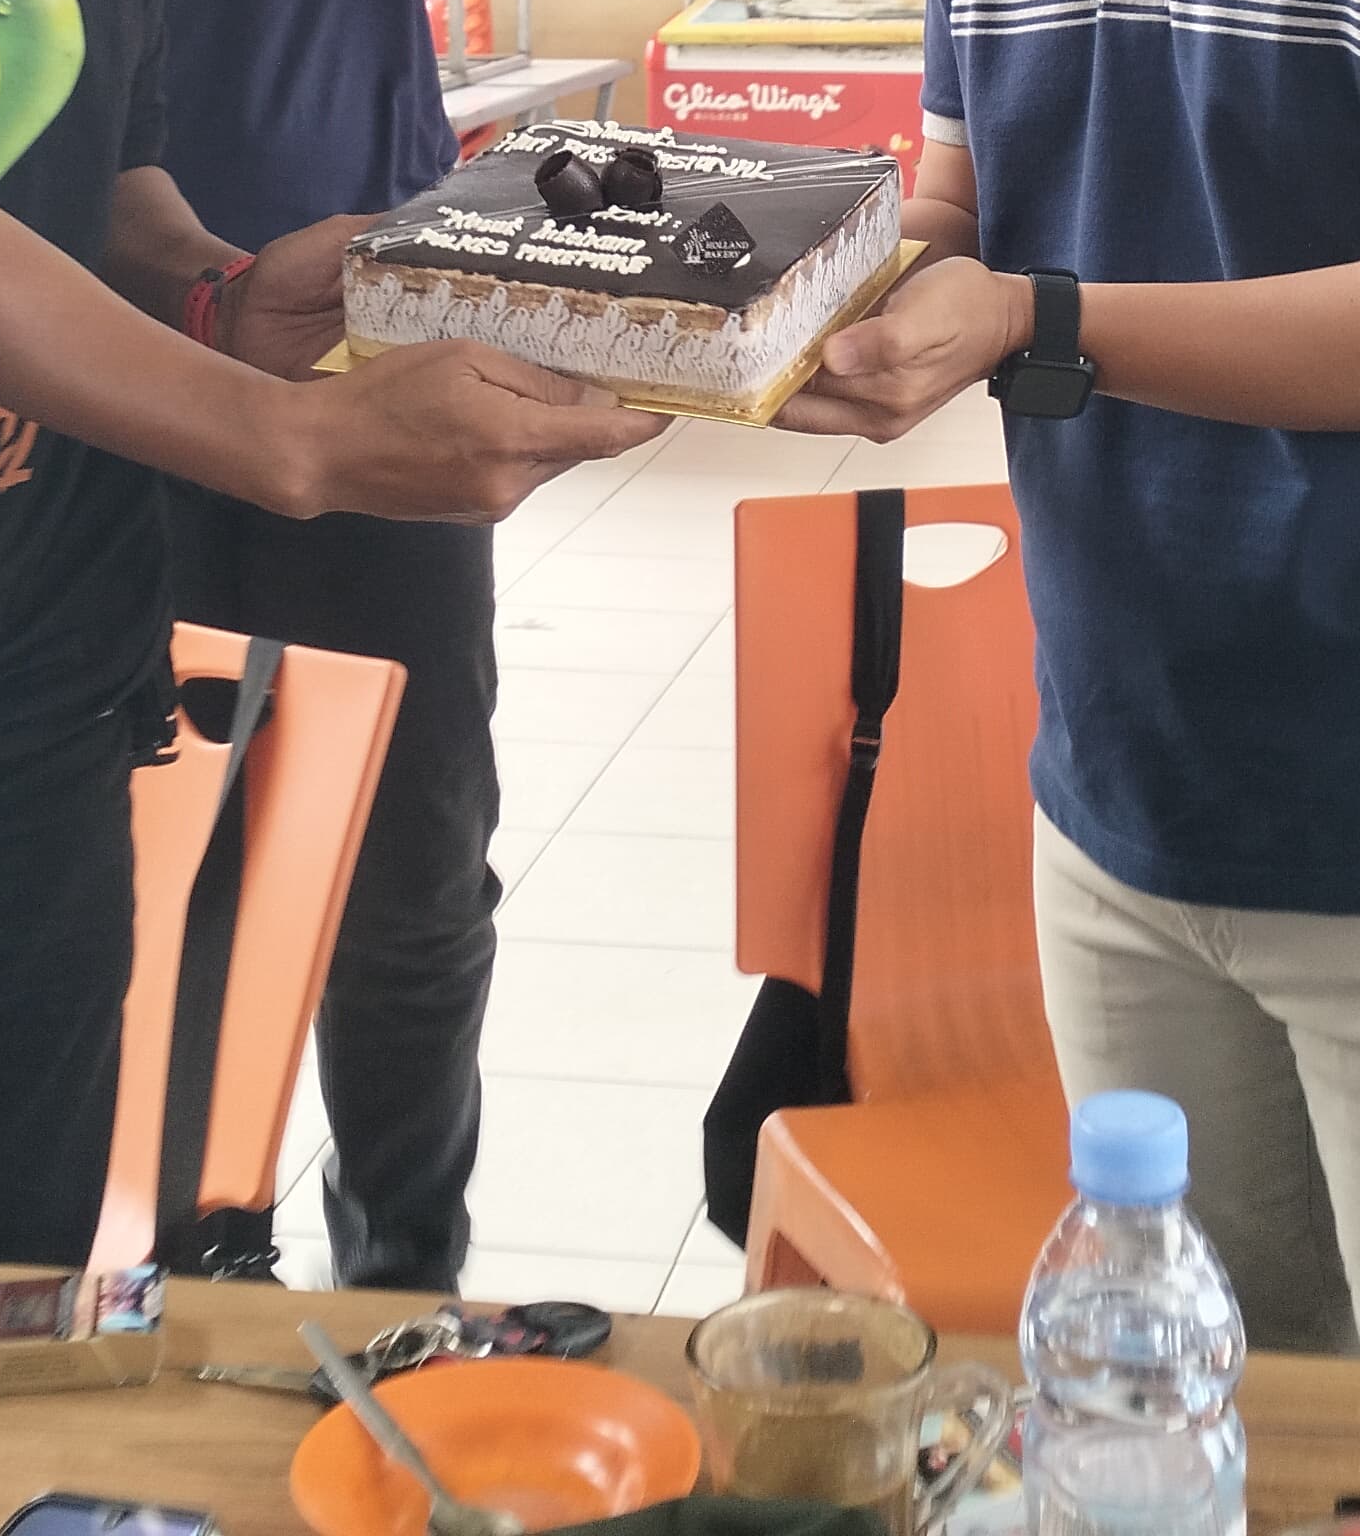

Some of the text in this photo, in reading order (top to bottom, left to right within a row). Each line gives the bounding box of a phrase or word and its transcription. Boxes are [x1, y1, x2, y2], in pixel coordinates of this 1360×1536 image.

[663, 82, 841, 121] Glico Wings
[706, 241, 749, 250] HOLLAND
[704, 250, 739, 259] BAKERY
